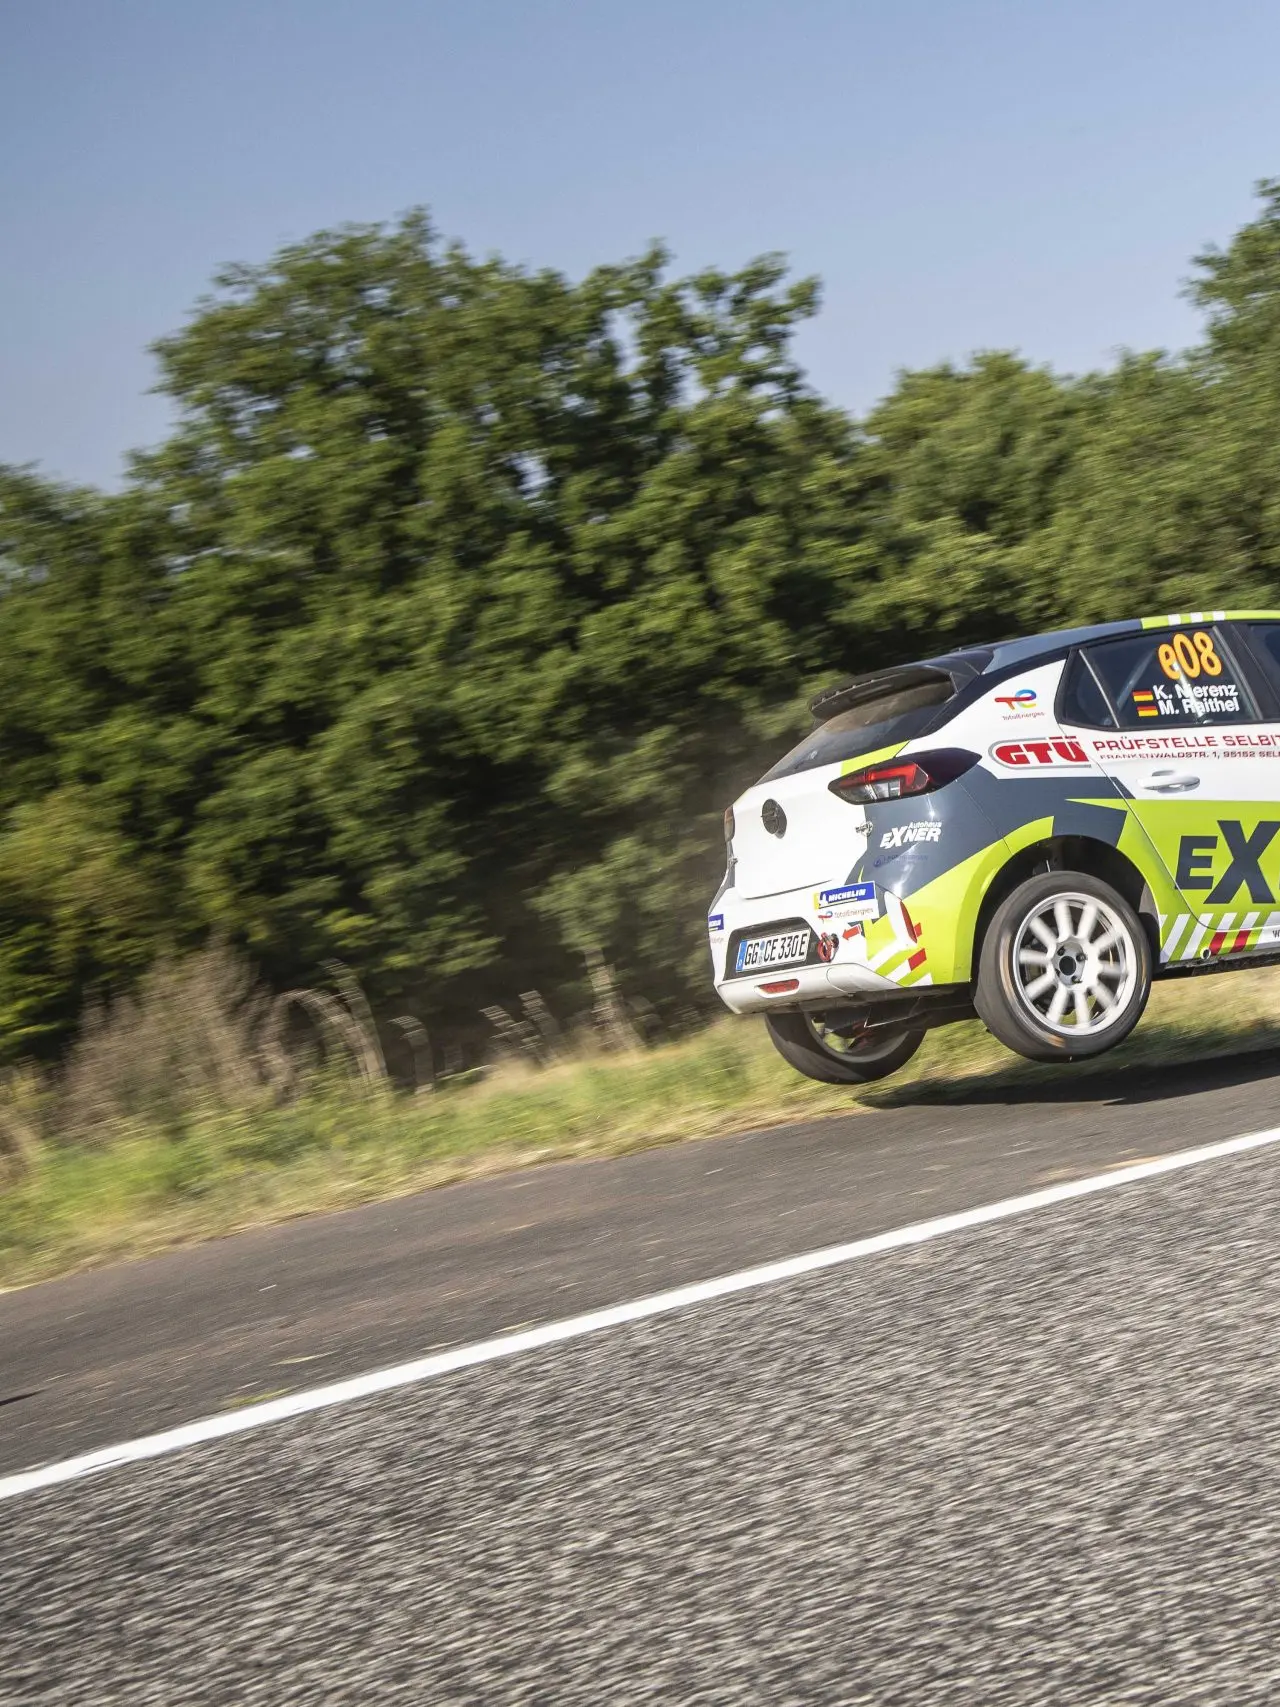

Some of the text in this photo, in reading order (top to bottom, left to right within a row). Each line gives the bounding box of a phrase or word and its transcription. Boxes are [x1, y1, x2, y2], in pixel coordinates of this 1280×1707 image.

[1158, 631, 1222, 680] e08
[1152, 684, 1173, 700] K.
[1157, 697, 1240, 715] M. Raithel
[995, 735, 1090, 765] GTÜ
[1092, 735, 1219, 751] PRÜFSTELLE
[908, 820, 943, 829] Autohaus
[879, 826, 942, 849] EXNER
[828, 888, 867, 902] MICHELIN
[745, 942, 760, 966] GG
[763, 939, 779, 963] CE
[778, 934, 800, 960] 330
